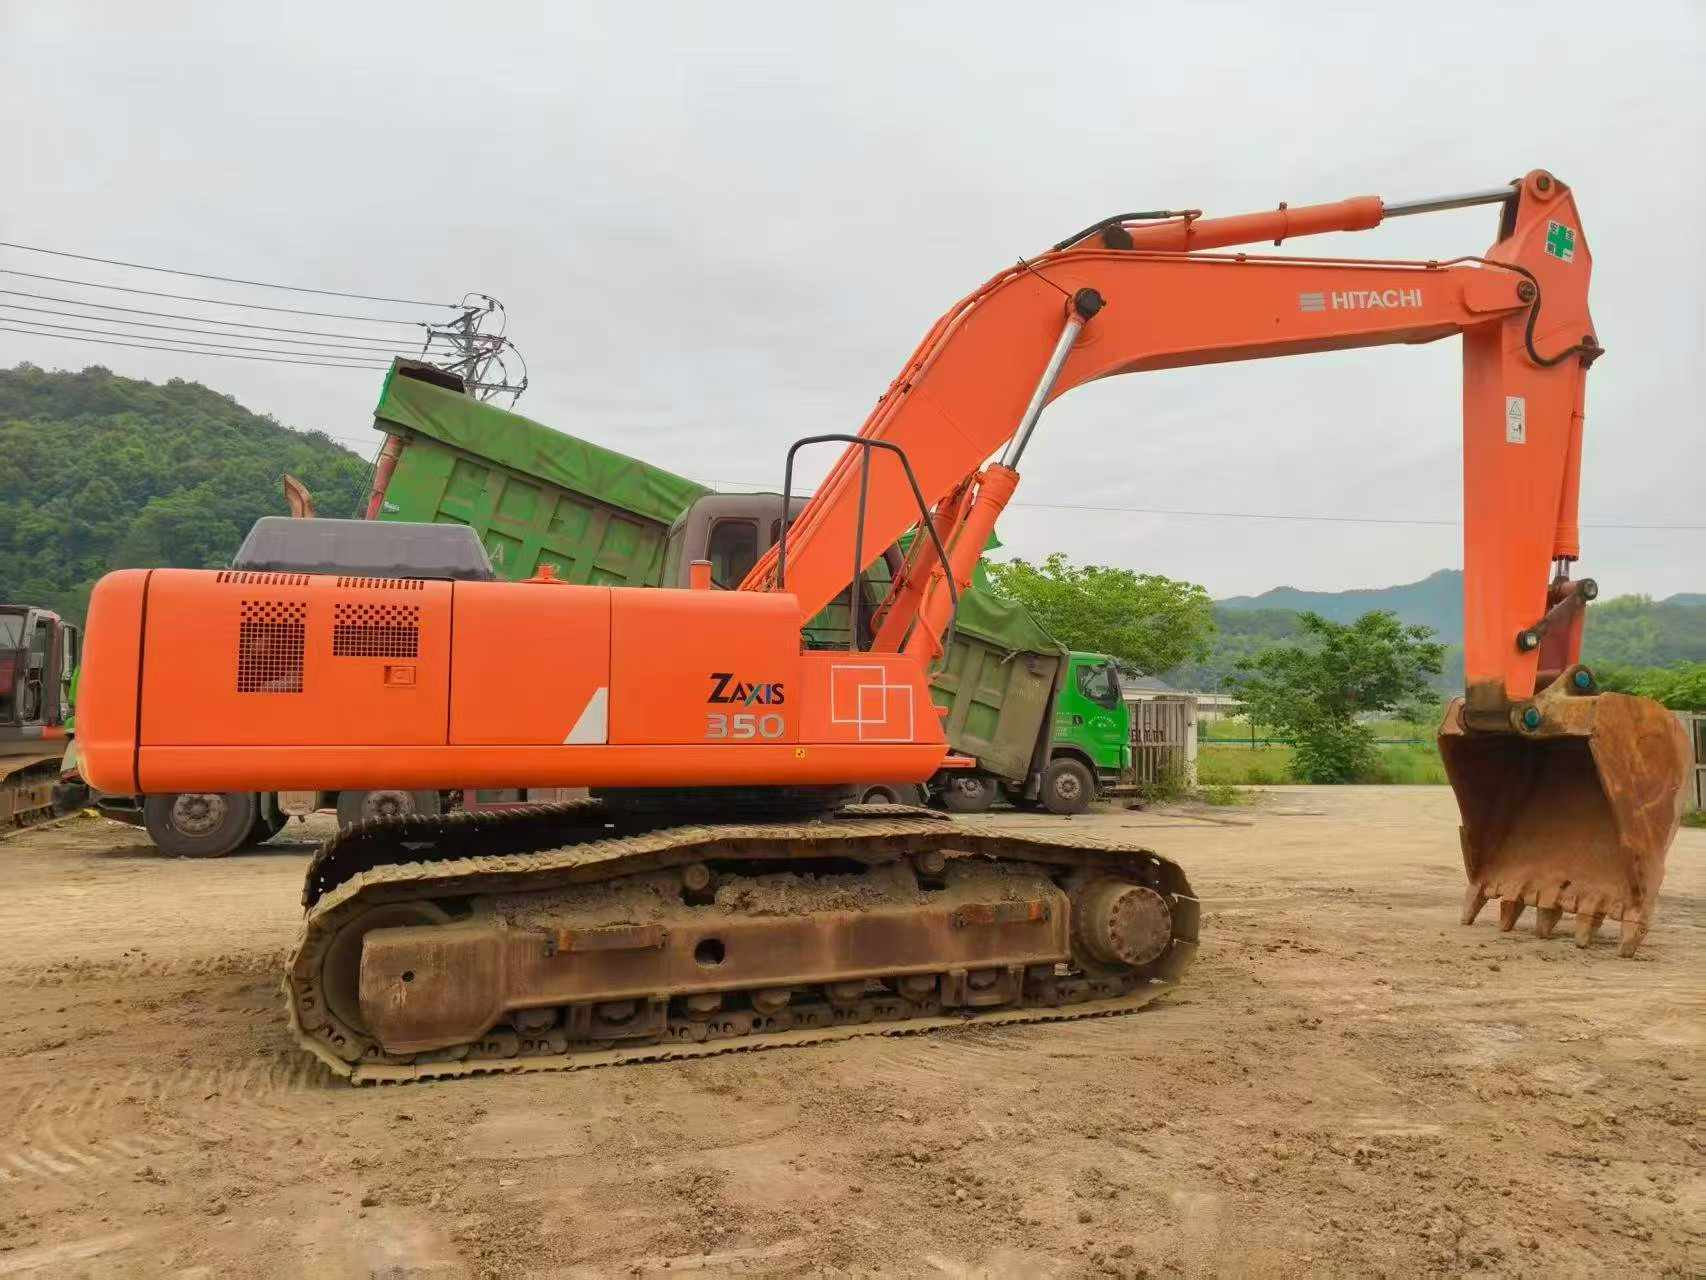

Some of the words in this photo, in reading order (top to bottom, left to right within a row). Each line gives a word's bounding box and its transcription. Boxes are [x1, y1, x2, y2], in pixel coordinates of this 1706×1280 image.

[1331, 289, 1423, 310] HITACHI
[707, 672, 785, 706] ZAXIS
[706, 713, 785, 738] 350
